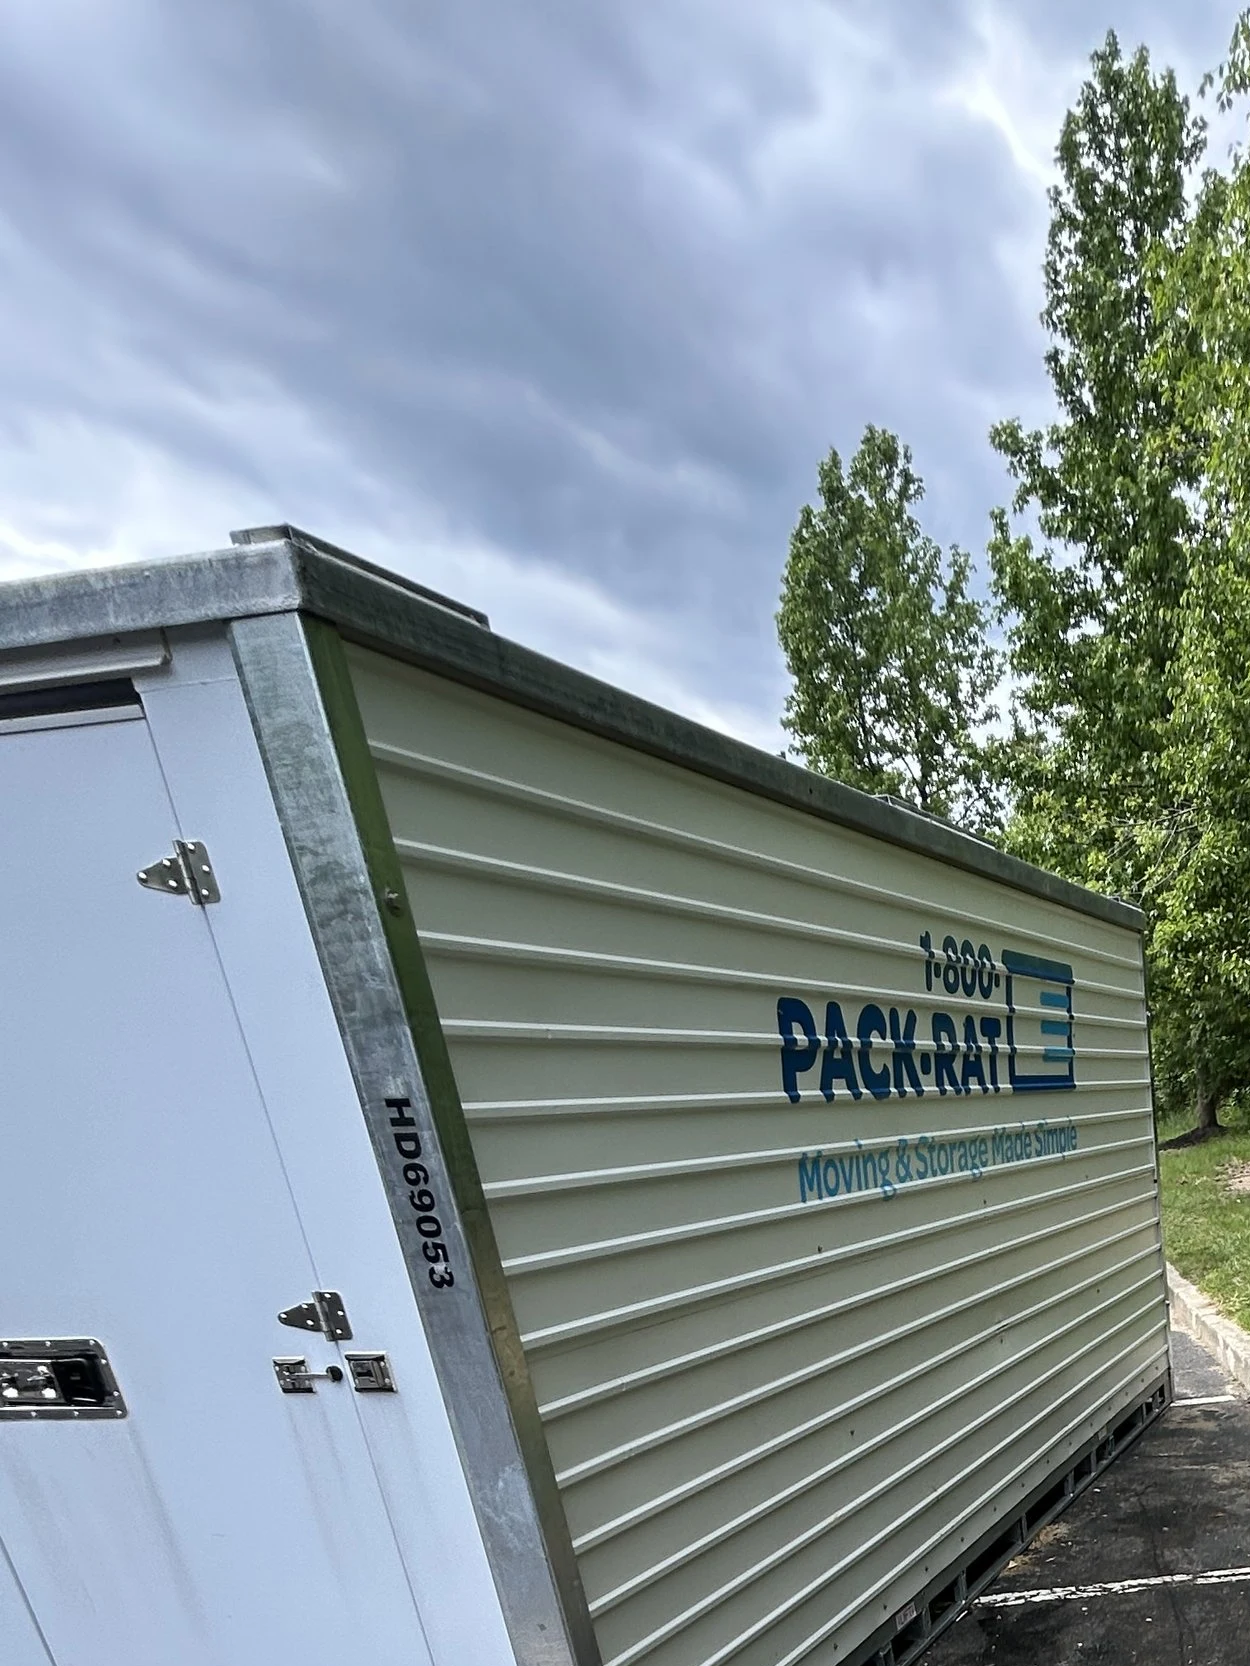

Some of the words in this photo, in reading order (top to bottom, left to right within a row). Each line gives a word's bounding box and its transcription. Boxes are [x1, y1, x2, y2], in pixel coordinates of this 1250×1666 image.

[383, 1096, 456, 1290] HD69053
[798, 1138, 897, 1202] Moving
[895, 1138, 914, 1184] &
[915, 1134, 990, 1183] Storage
[991, 1121, 1033, 1166] Made
[1034, 1116, 1078, 1160] Simple
